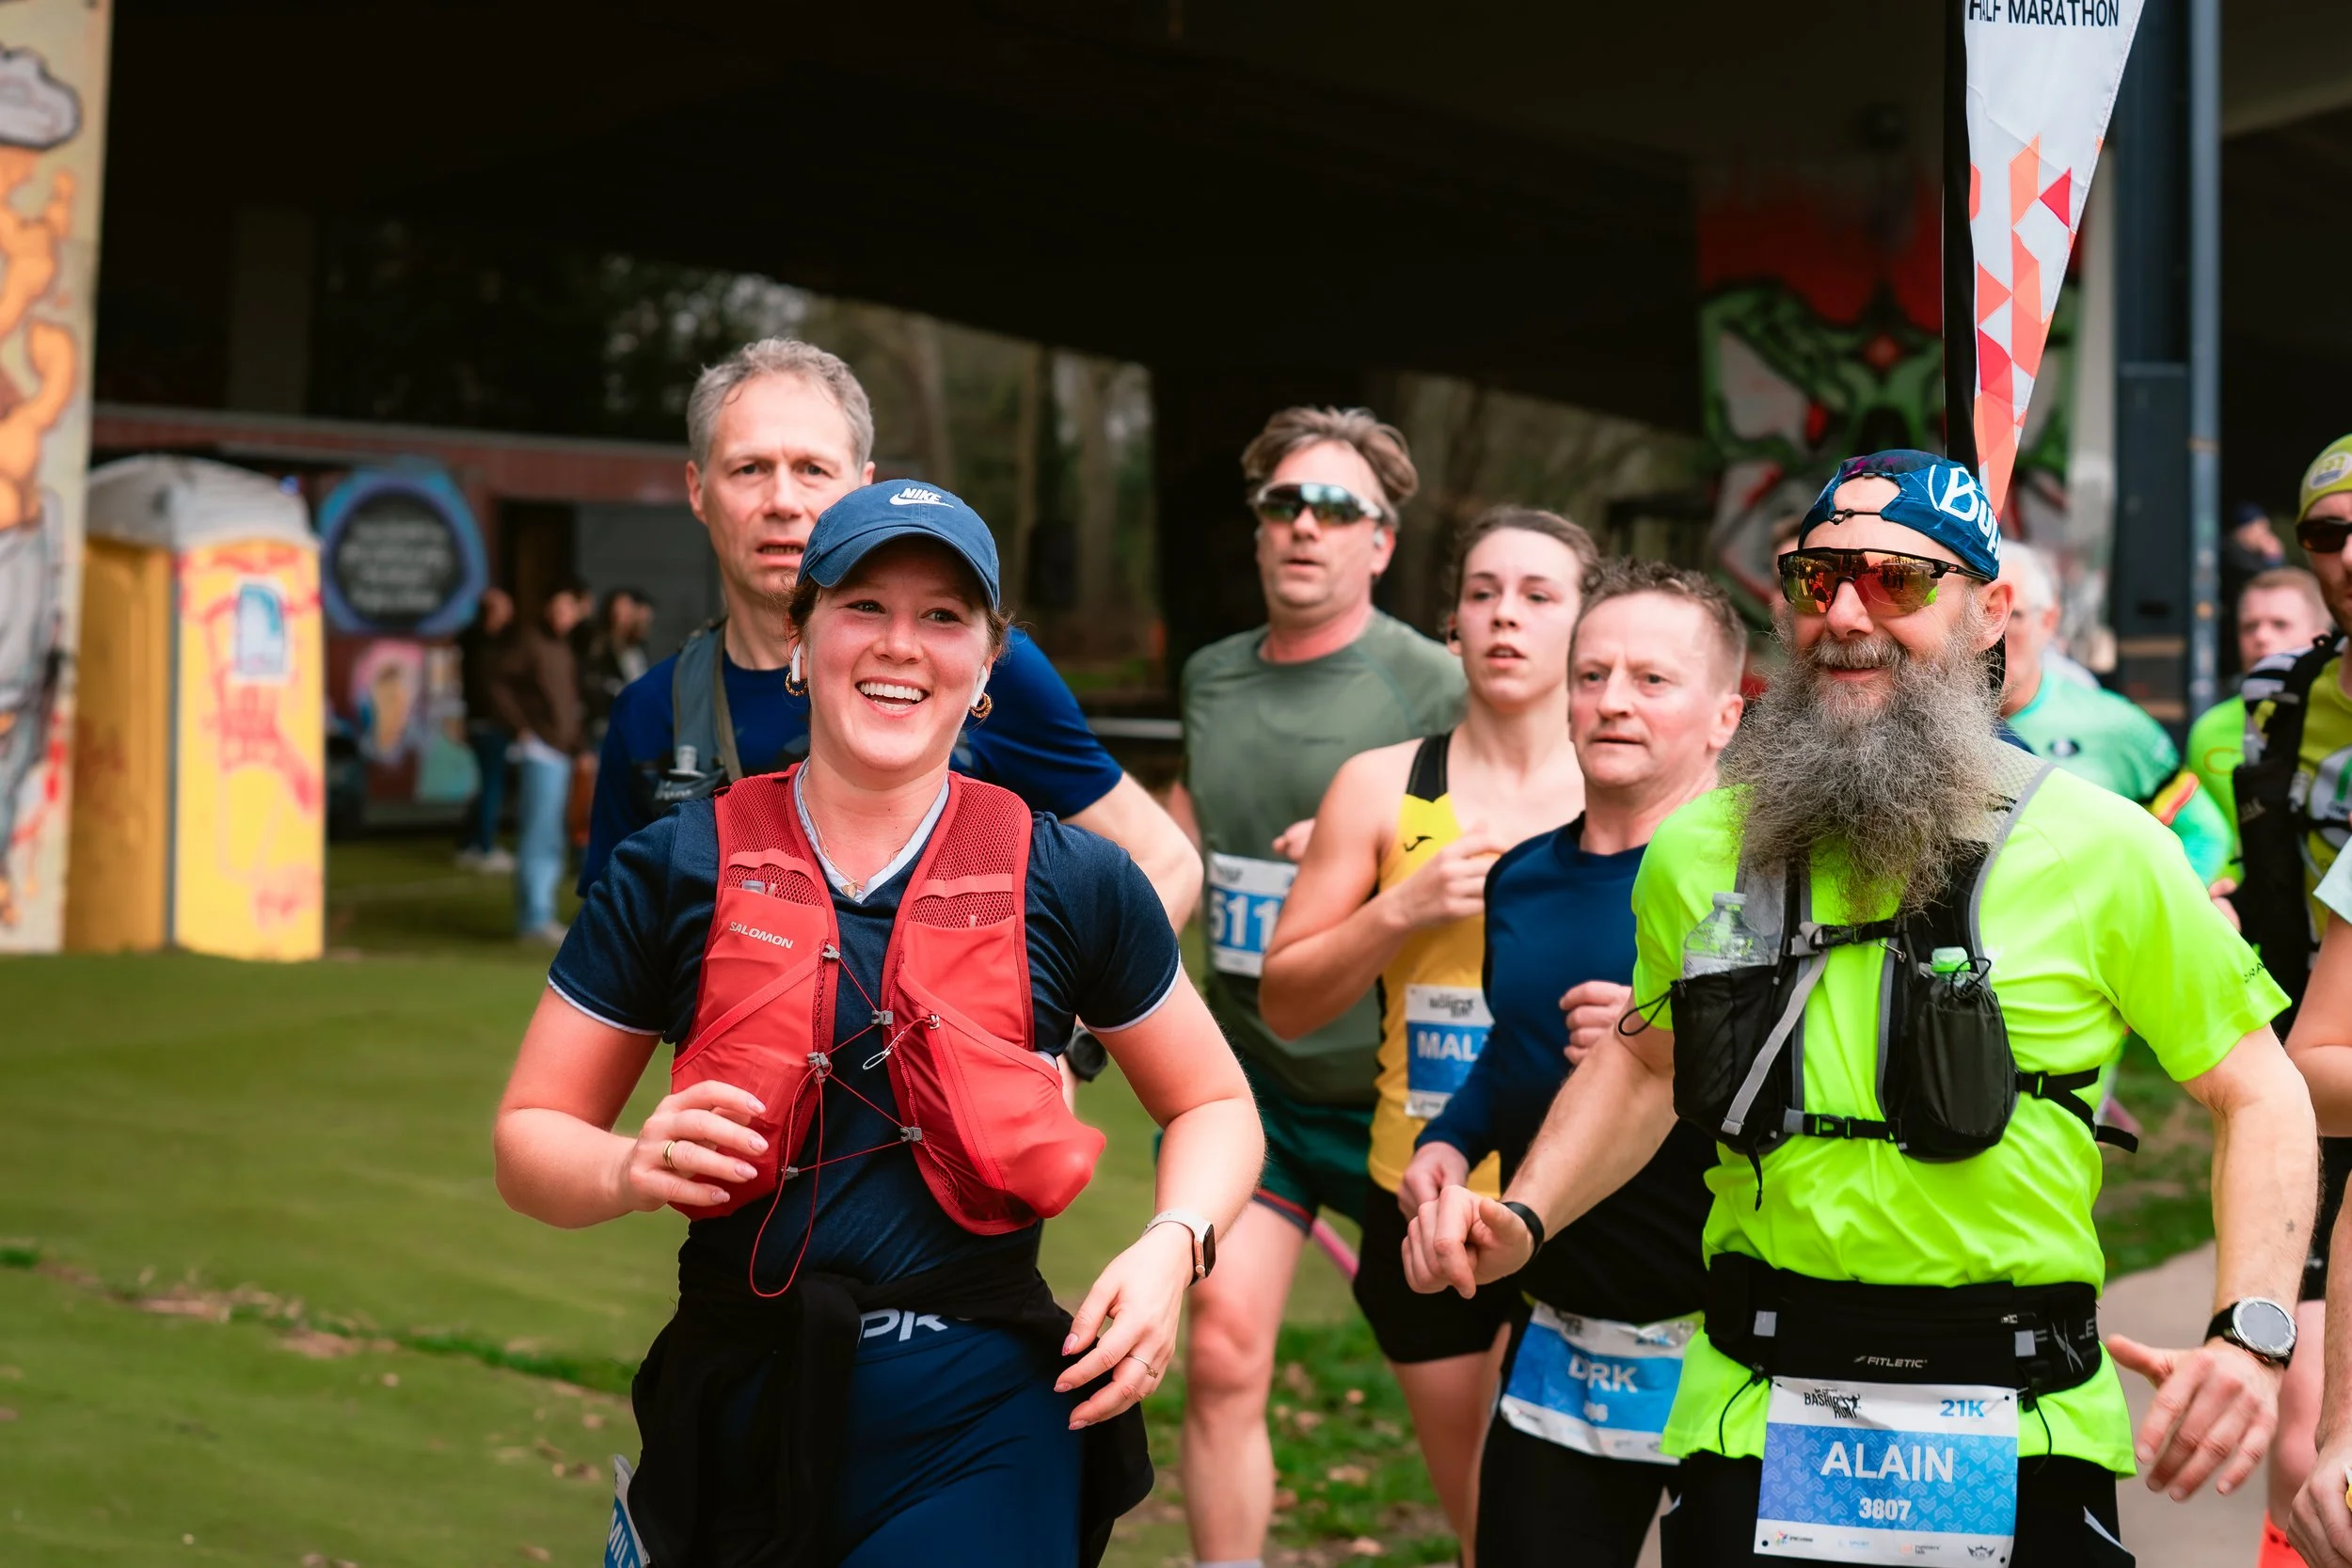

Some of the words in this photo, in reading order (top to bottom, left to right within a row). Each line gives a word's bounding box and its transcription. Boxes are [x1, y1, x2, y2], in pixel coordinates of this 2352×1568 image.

[2008, 0, 2119, 26] MARATHON
[900, 487, 942, 501] NIKE
[729, 921, 794, 949] SALOMON
[1417, 1031, 1488, 1062] MAL
[1867, 1356, 1924, 1369] FITLETIC
[1939, 1400, 1986, 1418] 21K
[1820, 1441, 1954, 1483] ALAIN
[1858, 1497, 1912, 1521] 3807
